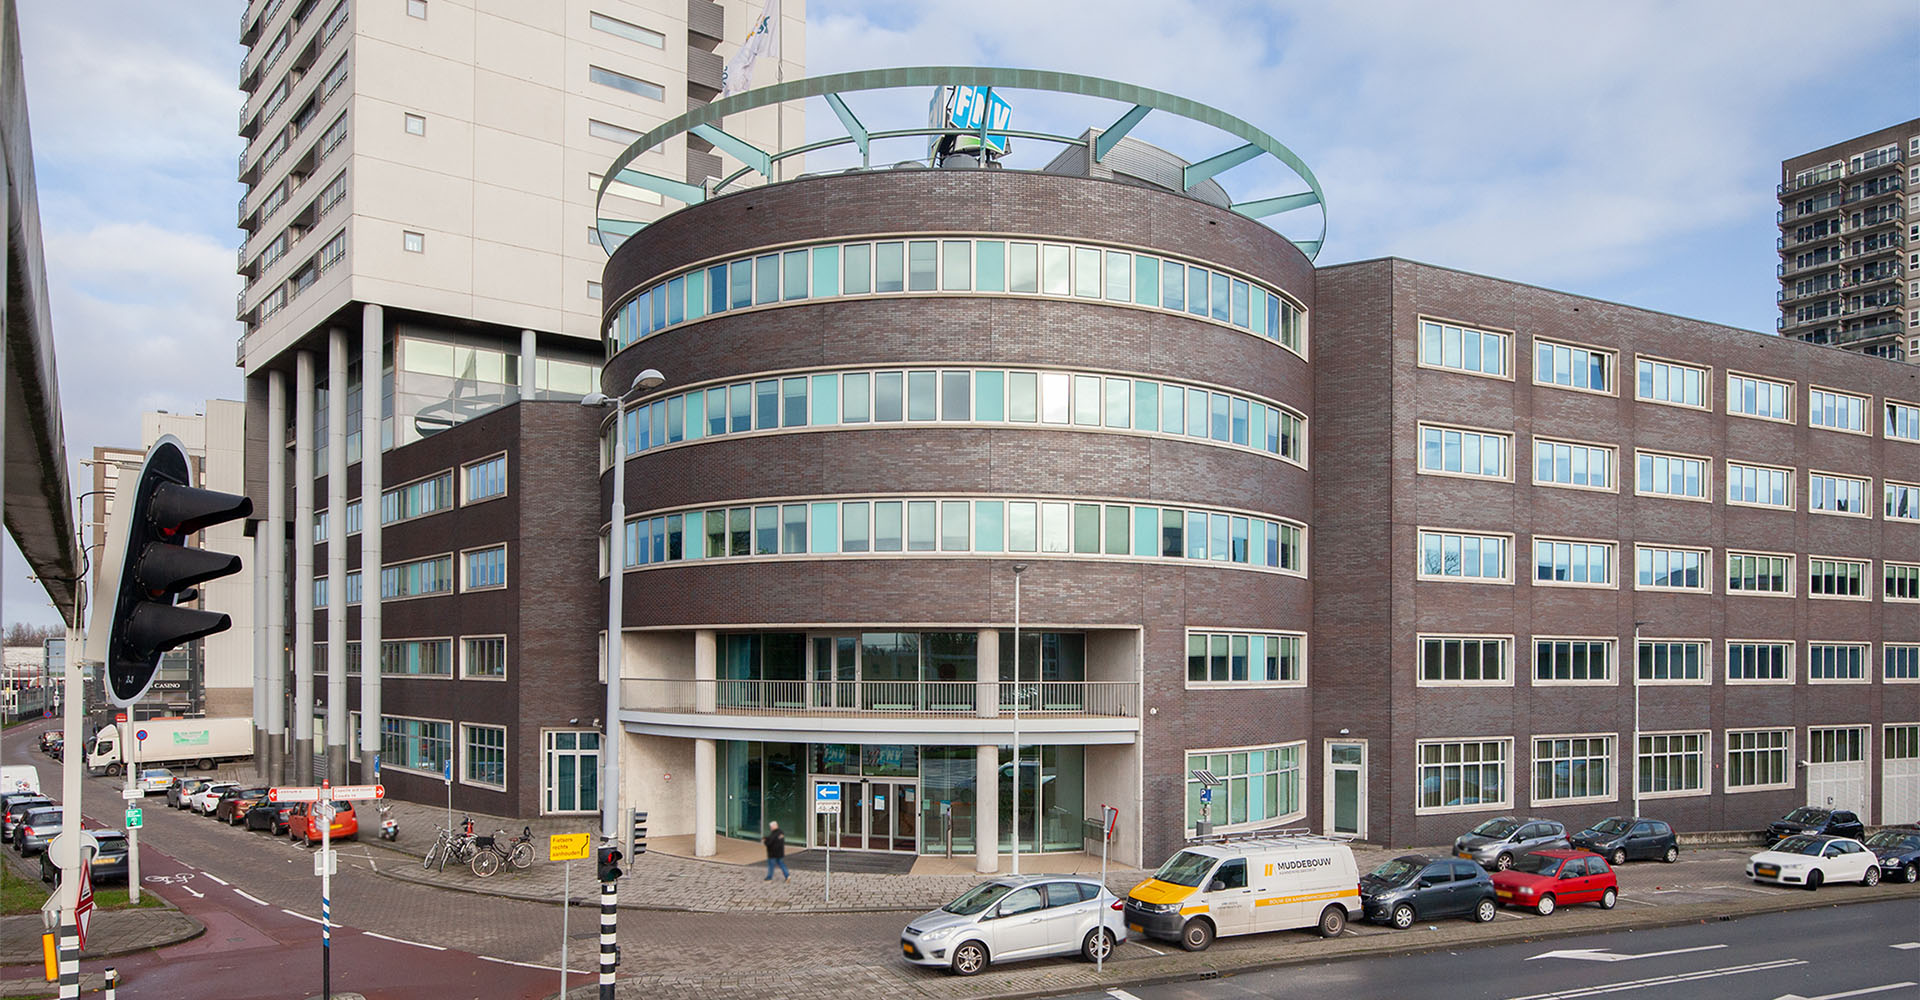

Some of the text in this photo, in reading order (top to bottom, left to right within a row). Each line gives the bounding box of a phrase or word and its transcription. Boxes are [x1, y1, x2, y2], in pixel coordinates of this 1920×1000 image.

[956, 85, 1010, 130] FNV
[879, 749, 904, 761] FNV
[1278, 858, 1331, 870] MUDDEBOUW
